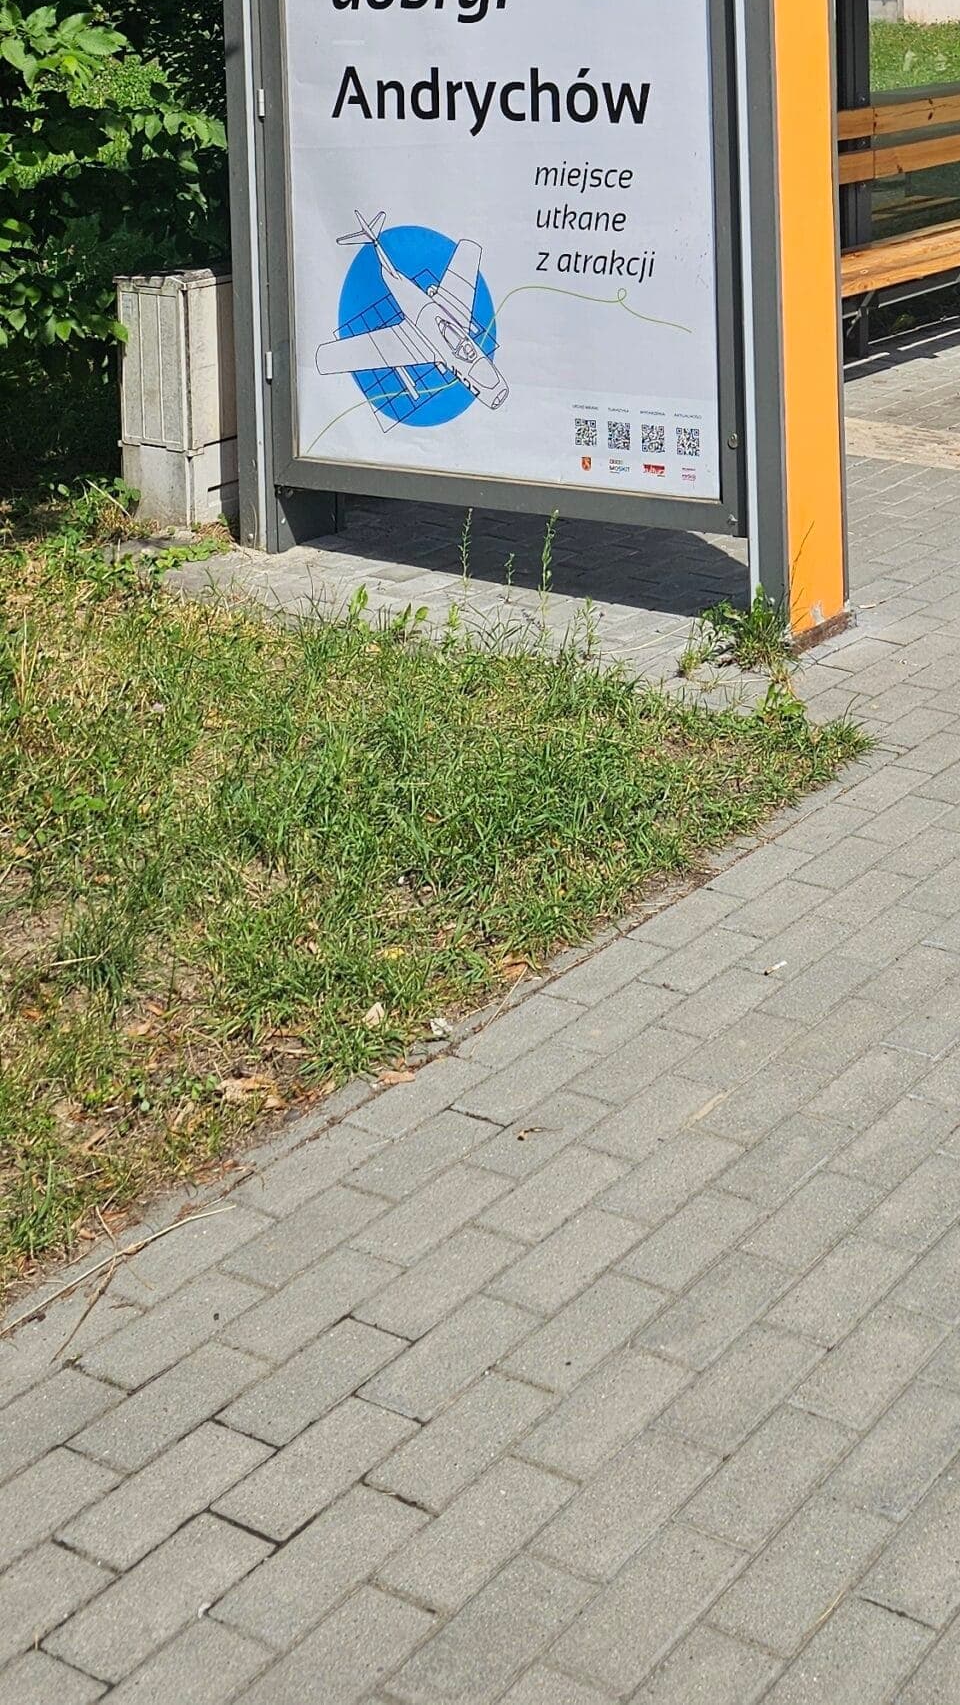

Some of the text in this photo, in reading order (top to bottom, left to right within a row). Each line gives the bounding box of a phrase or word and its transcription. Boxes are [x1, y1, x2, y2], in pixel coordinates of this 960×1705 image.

[331, 66, 651, 137] Andrychów
[534, 160, 634, 193] miejsce
[536, 203, 627, 232] utkane
[535, 249, 656, 283] z atrakcji
